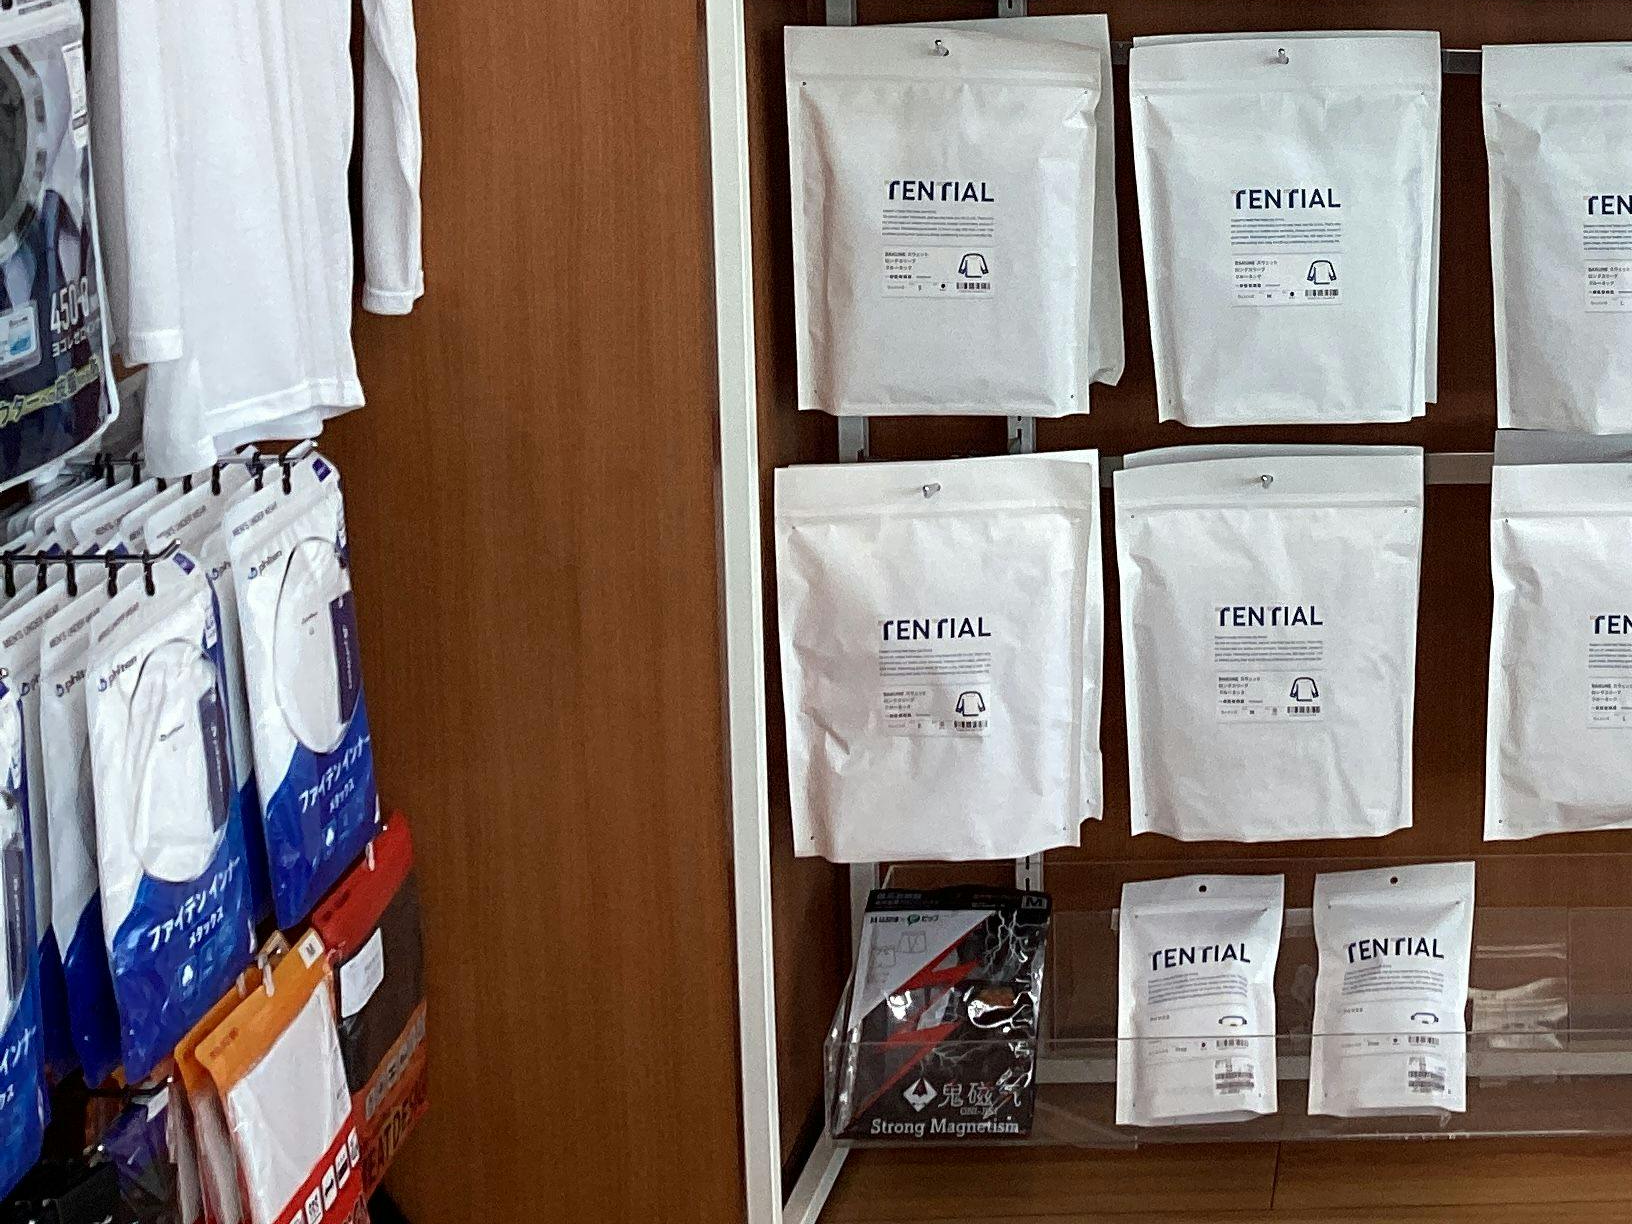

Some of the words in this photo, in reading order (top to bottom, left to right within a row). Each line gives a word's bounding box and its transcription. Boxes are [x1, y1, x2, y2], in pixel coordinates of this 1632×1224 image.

[884, 180, 995, 203] TENTIAL
[1231, 188, 1341, 210] TENTIAL
[1215, 605, 1324, 626] TENTIAL
[879, 616, 992, 641] TENTIAL
[147, 883, 206, 952] ファイテン
[1150, 942, 1251, 971] TENTIAL
[1345, 936, 1445, 963] TENTIAL
[871, 1118, 925, 1138] Strong
[929, 1118, 1020, 1137] Magnetism
